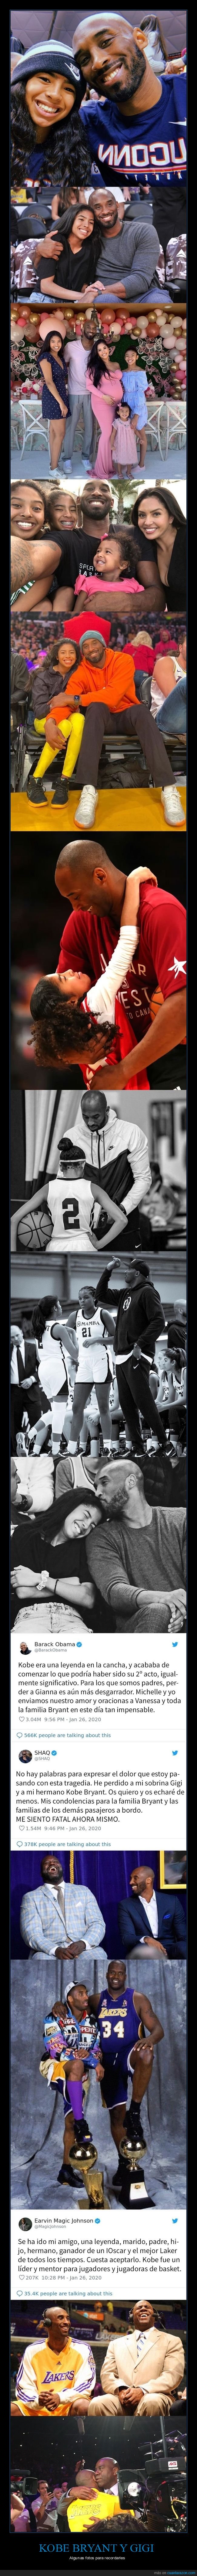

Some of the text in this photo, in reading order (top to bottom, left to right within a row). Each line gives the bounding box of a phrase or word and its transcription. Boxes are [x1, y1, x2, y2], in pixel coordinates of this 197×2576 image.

[62, 1198, 80, 1230] 2
[82, 1327, 92, 1338] 21
[98, 2007, 127, 2019] LAKERS
[102, 2021, 124, 2038] 34
[41, 2370, 75, 2384] LAKERS
[68, 2504, 102, 2520] LAKERS
